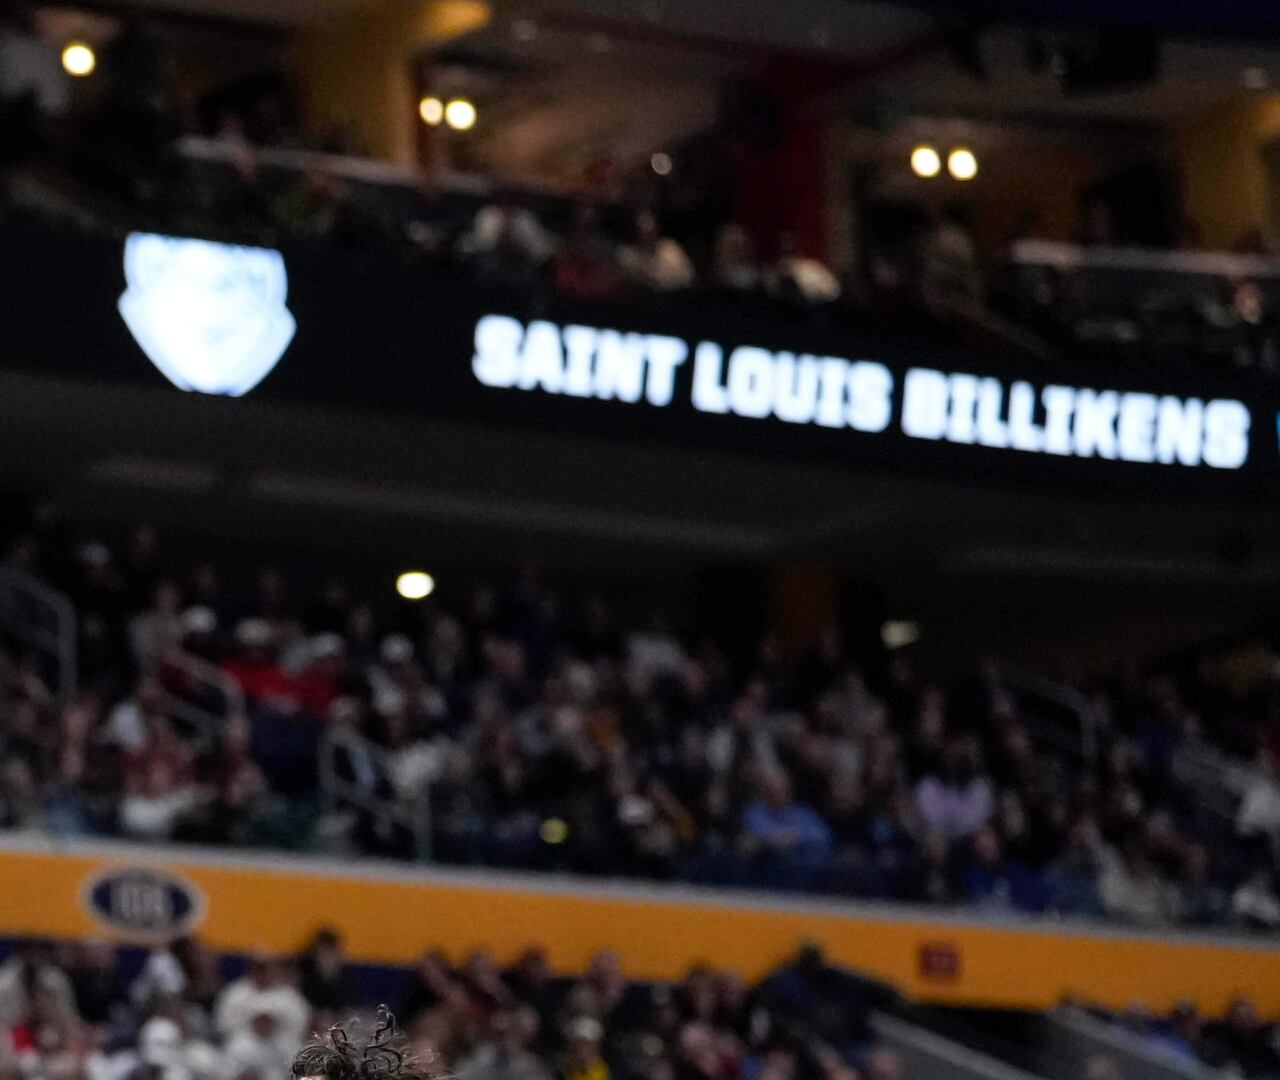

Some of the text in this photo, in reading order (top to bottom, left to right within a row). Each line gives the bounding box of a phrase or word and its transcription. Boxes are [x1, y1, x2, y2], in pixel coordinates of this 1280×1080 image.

[473, 314, 1250, 469] SAINT LOUIS BILLIKENS
